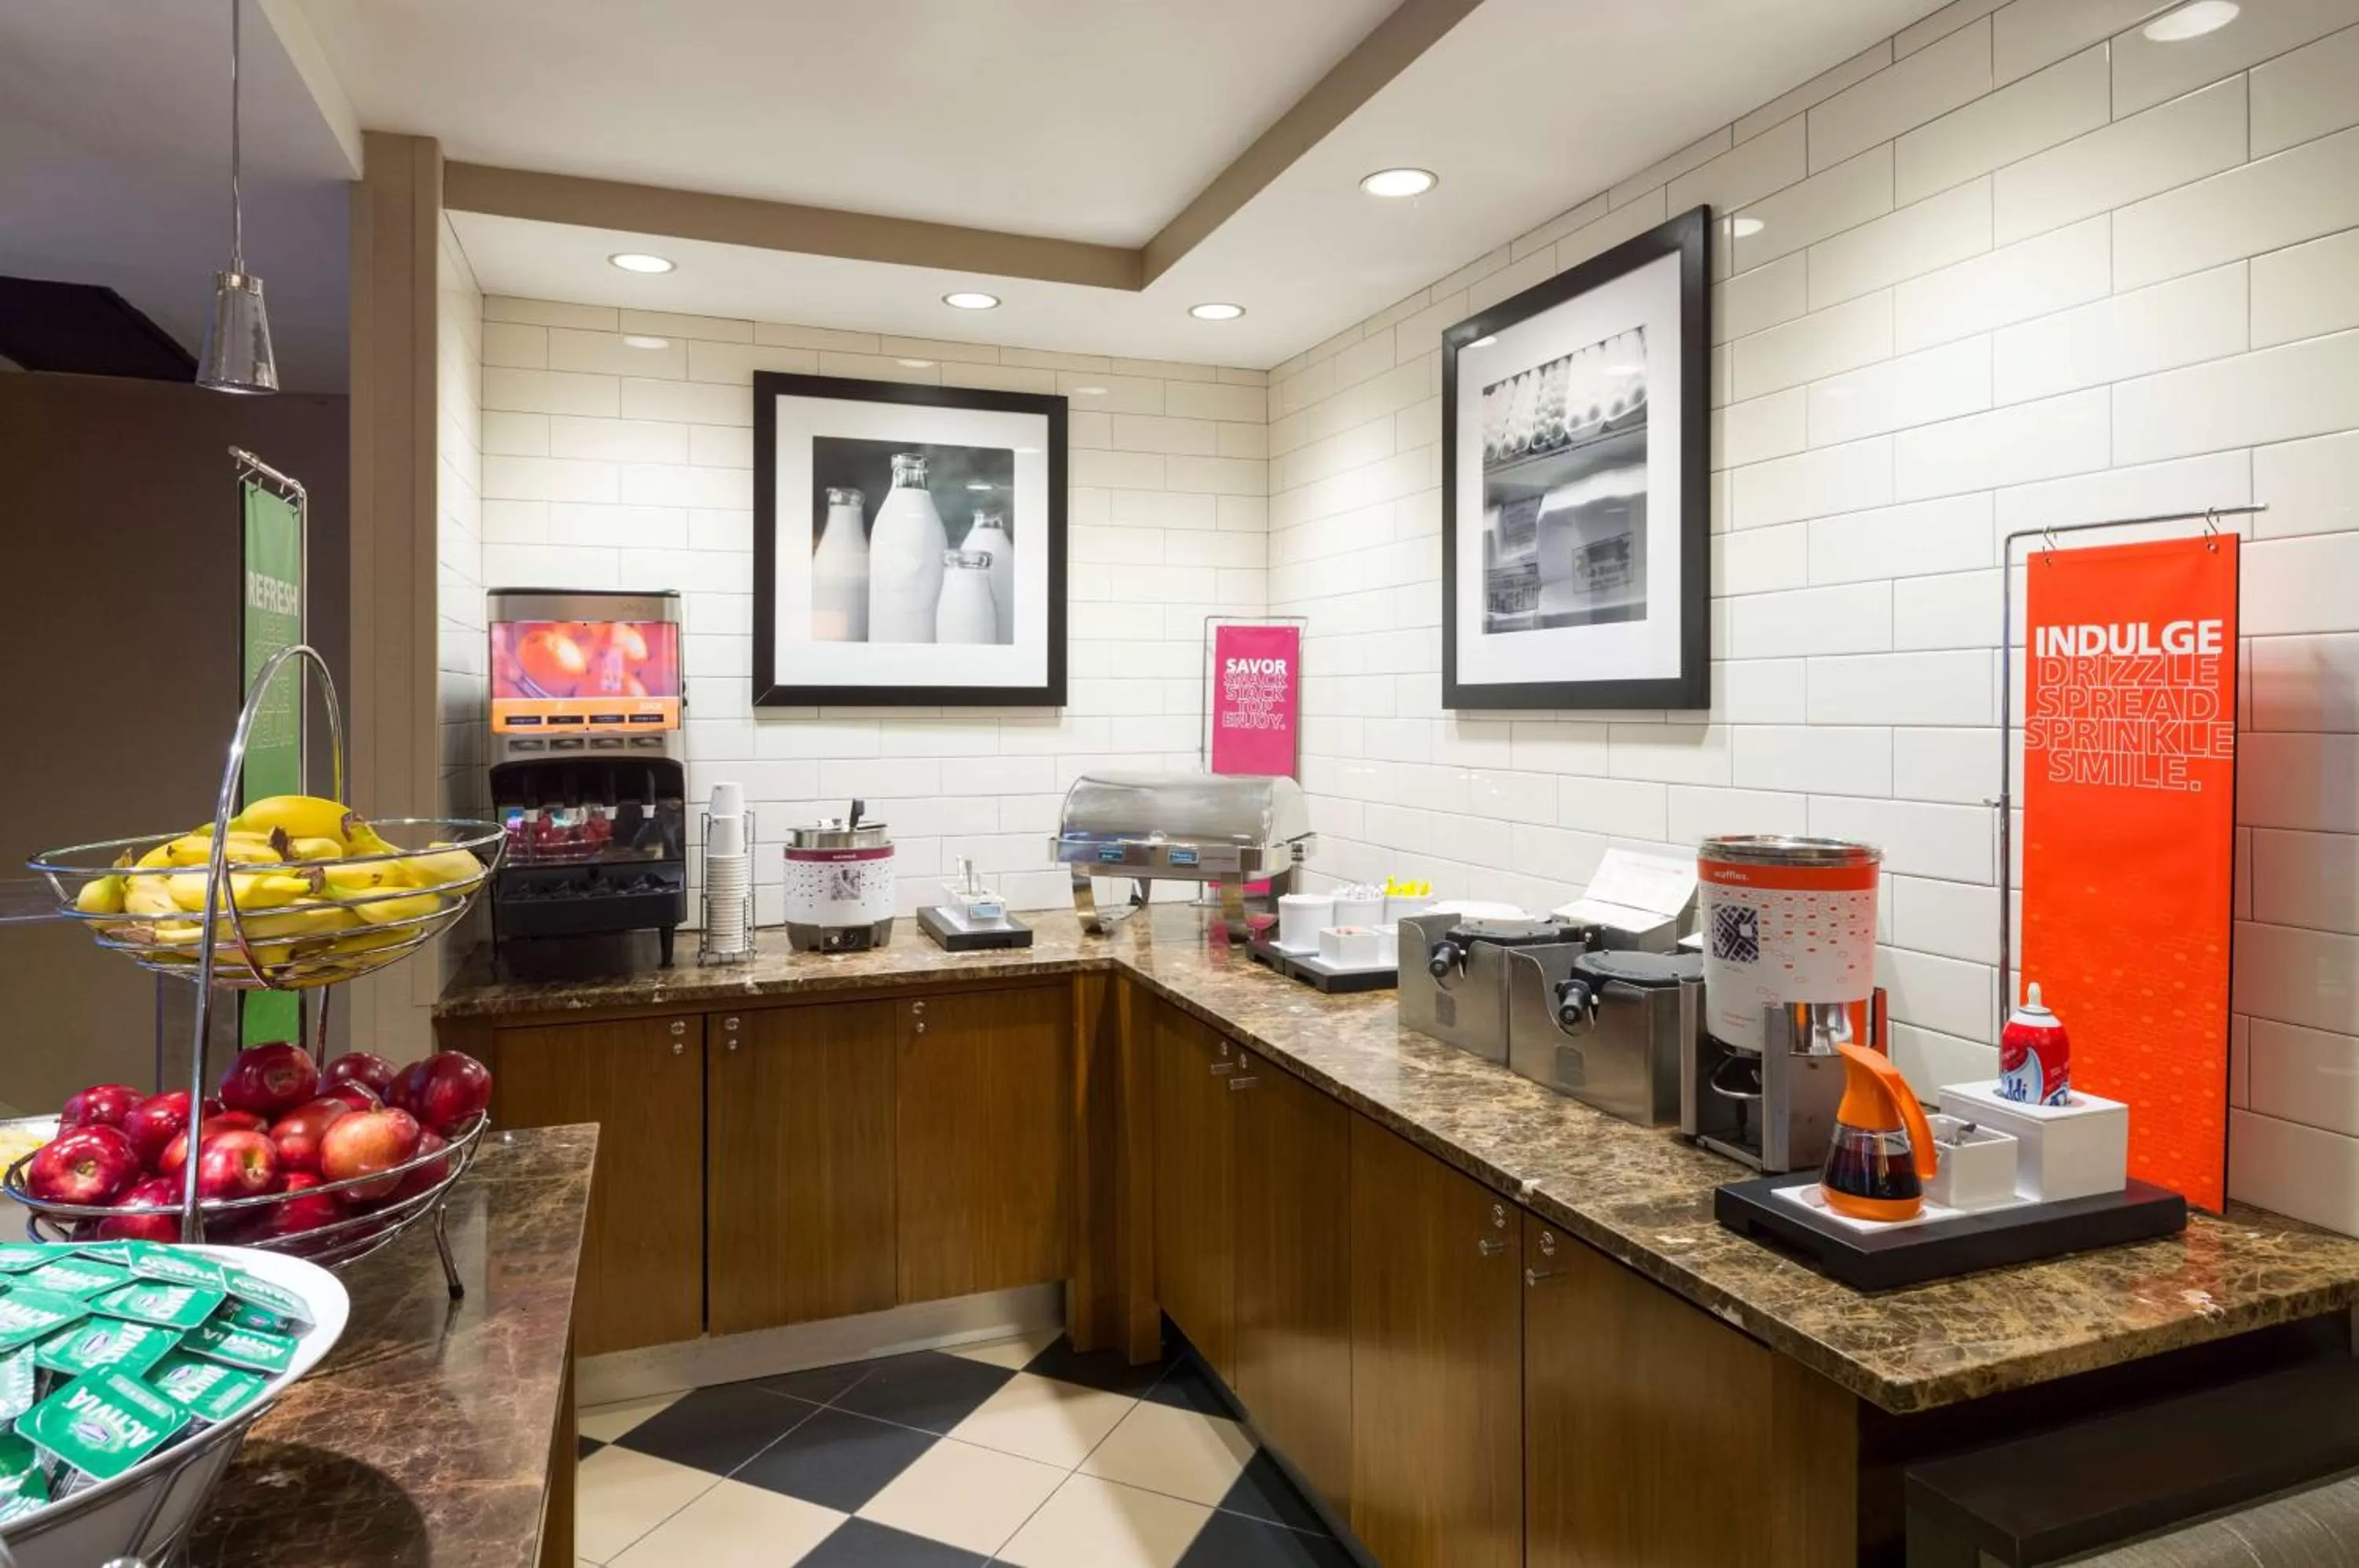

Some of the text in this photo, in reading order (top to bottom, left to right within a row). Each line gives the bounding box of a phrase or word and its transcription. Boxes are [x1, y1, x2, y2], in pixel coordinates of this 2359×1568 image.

[248, 570, 298, 617] REFRESH
[2036, 620, 2223, 657] INDULGE
[1226, 658, 1286, 674] SAVOR
[2037, 653, 2218, 690] DRIZZLE
[1226, 686, 1286, 701] STACK
[1237, 698, 1273, 715] TOP
[2036, 686, 2220, 722] SPREAD
[1222, 711, 1286, 730] ENJOY.
[2024, 716, 2234, 759] SPRINKLE
[2048, 749, 2202, 792] SMILE.
[61, 1386, 160, 1449] ACTIVIA
